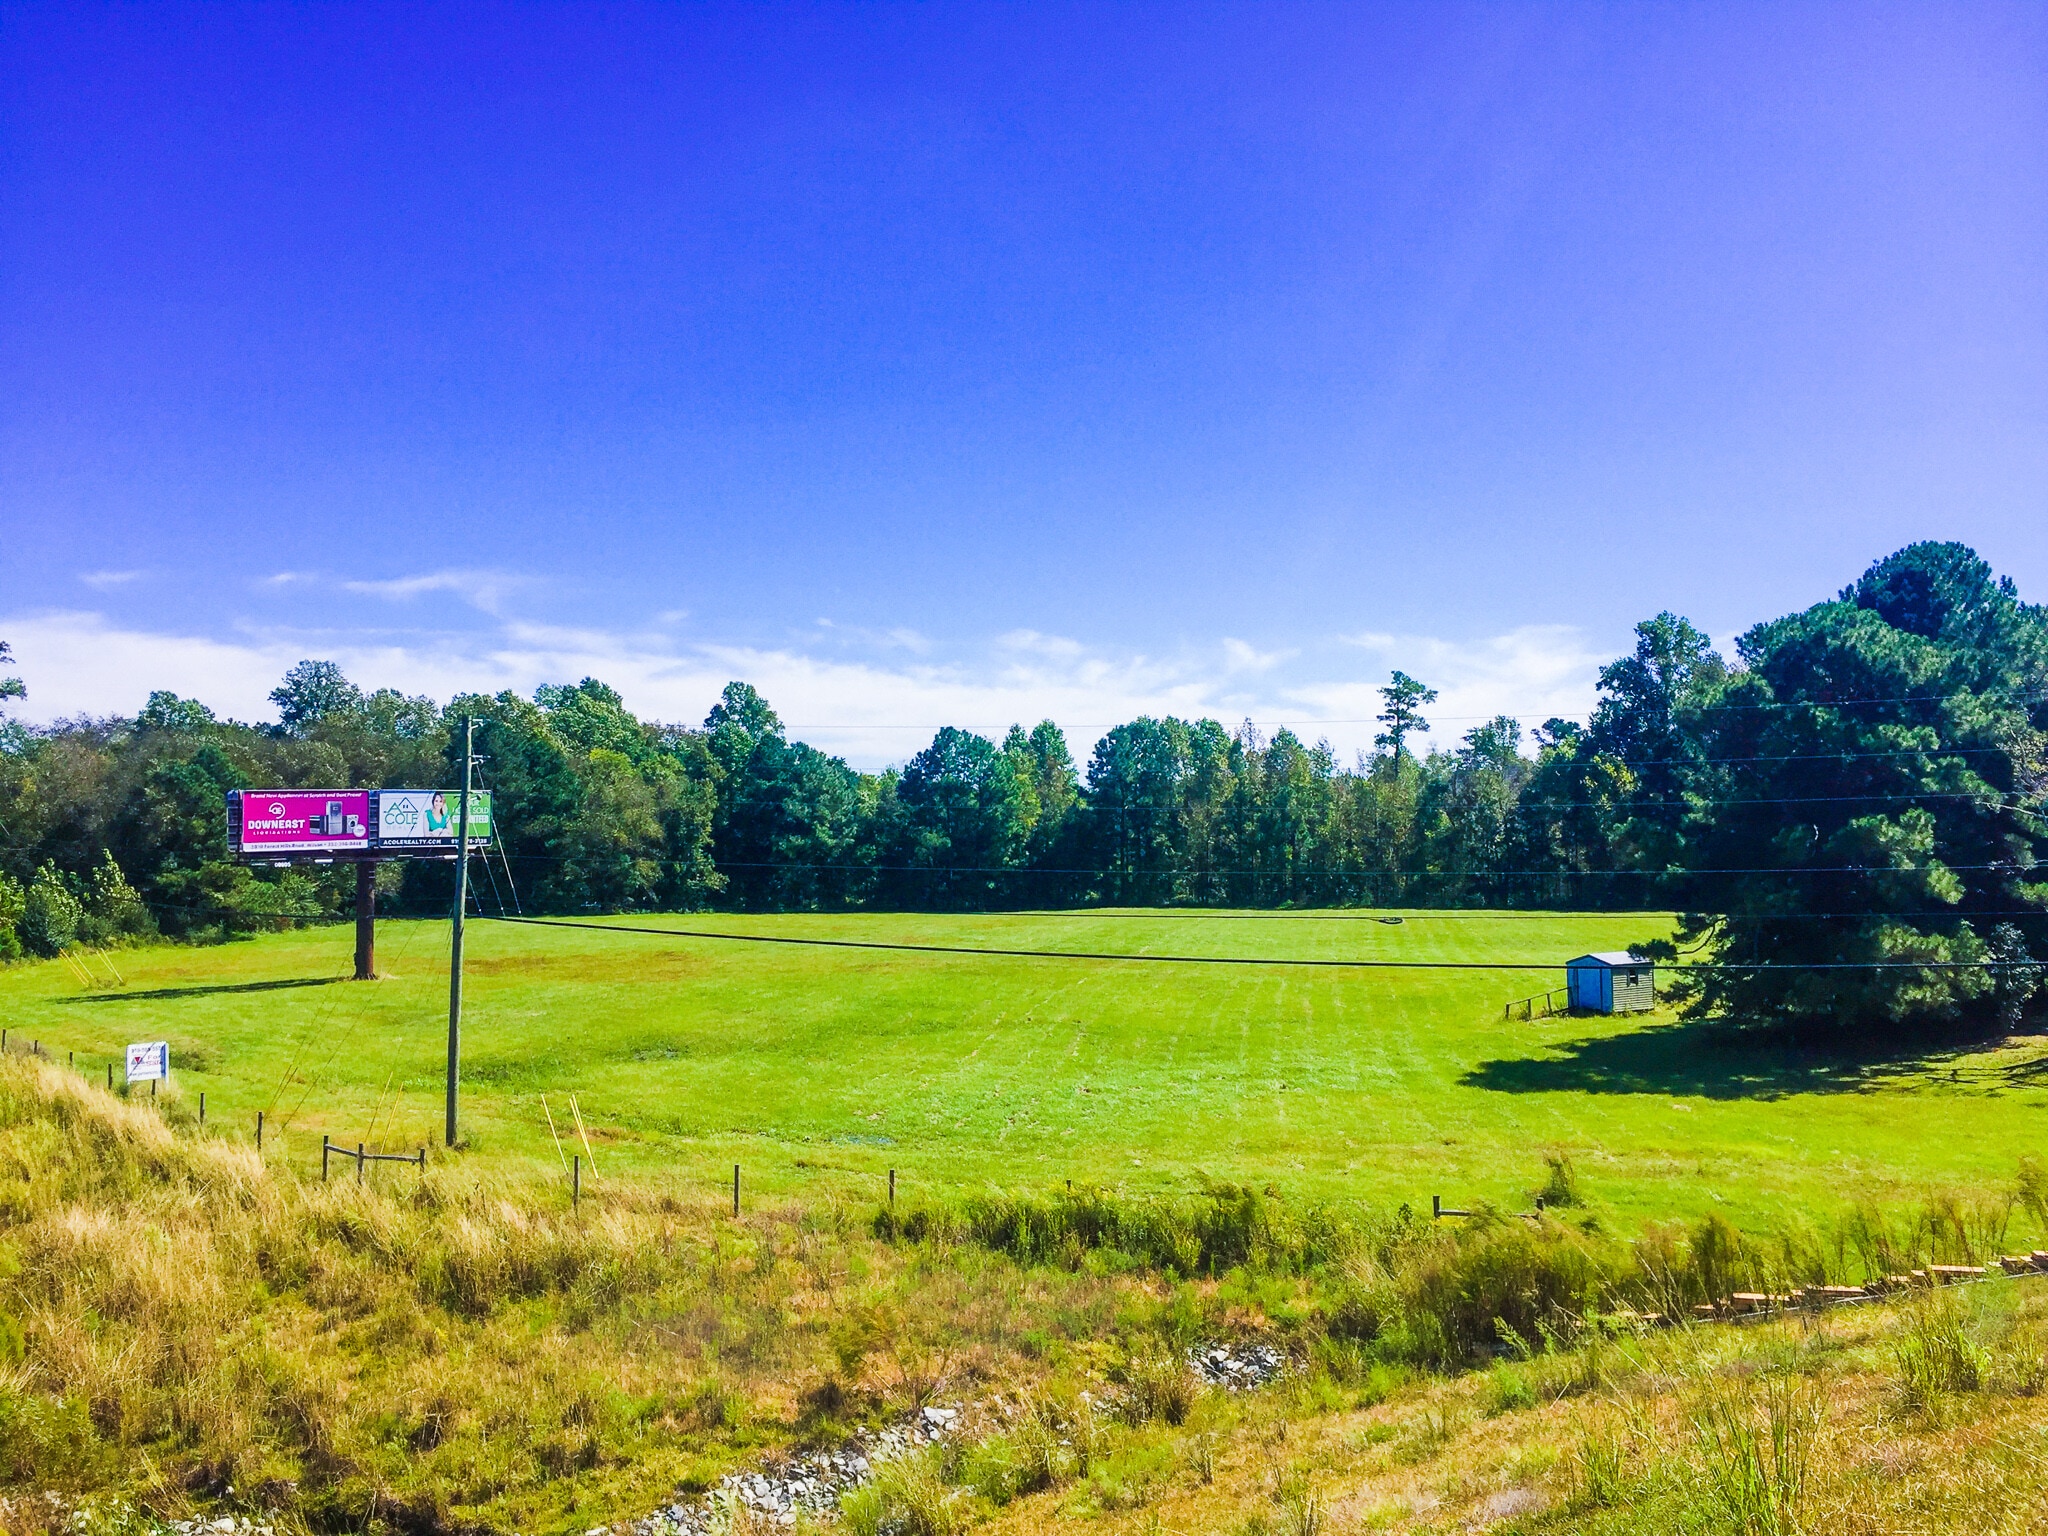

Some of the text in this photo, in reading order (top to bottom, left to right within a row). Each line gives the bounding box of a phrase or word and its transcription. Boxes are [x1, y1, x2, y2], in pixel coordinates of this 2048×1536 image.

[472, 806, 489, 814] SOLD
[248, 819, 306, 830] DOWNEAST
[385, 813, 418, 825] COLE
